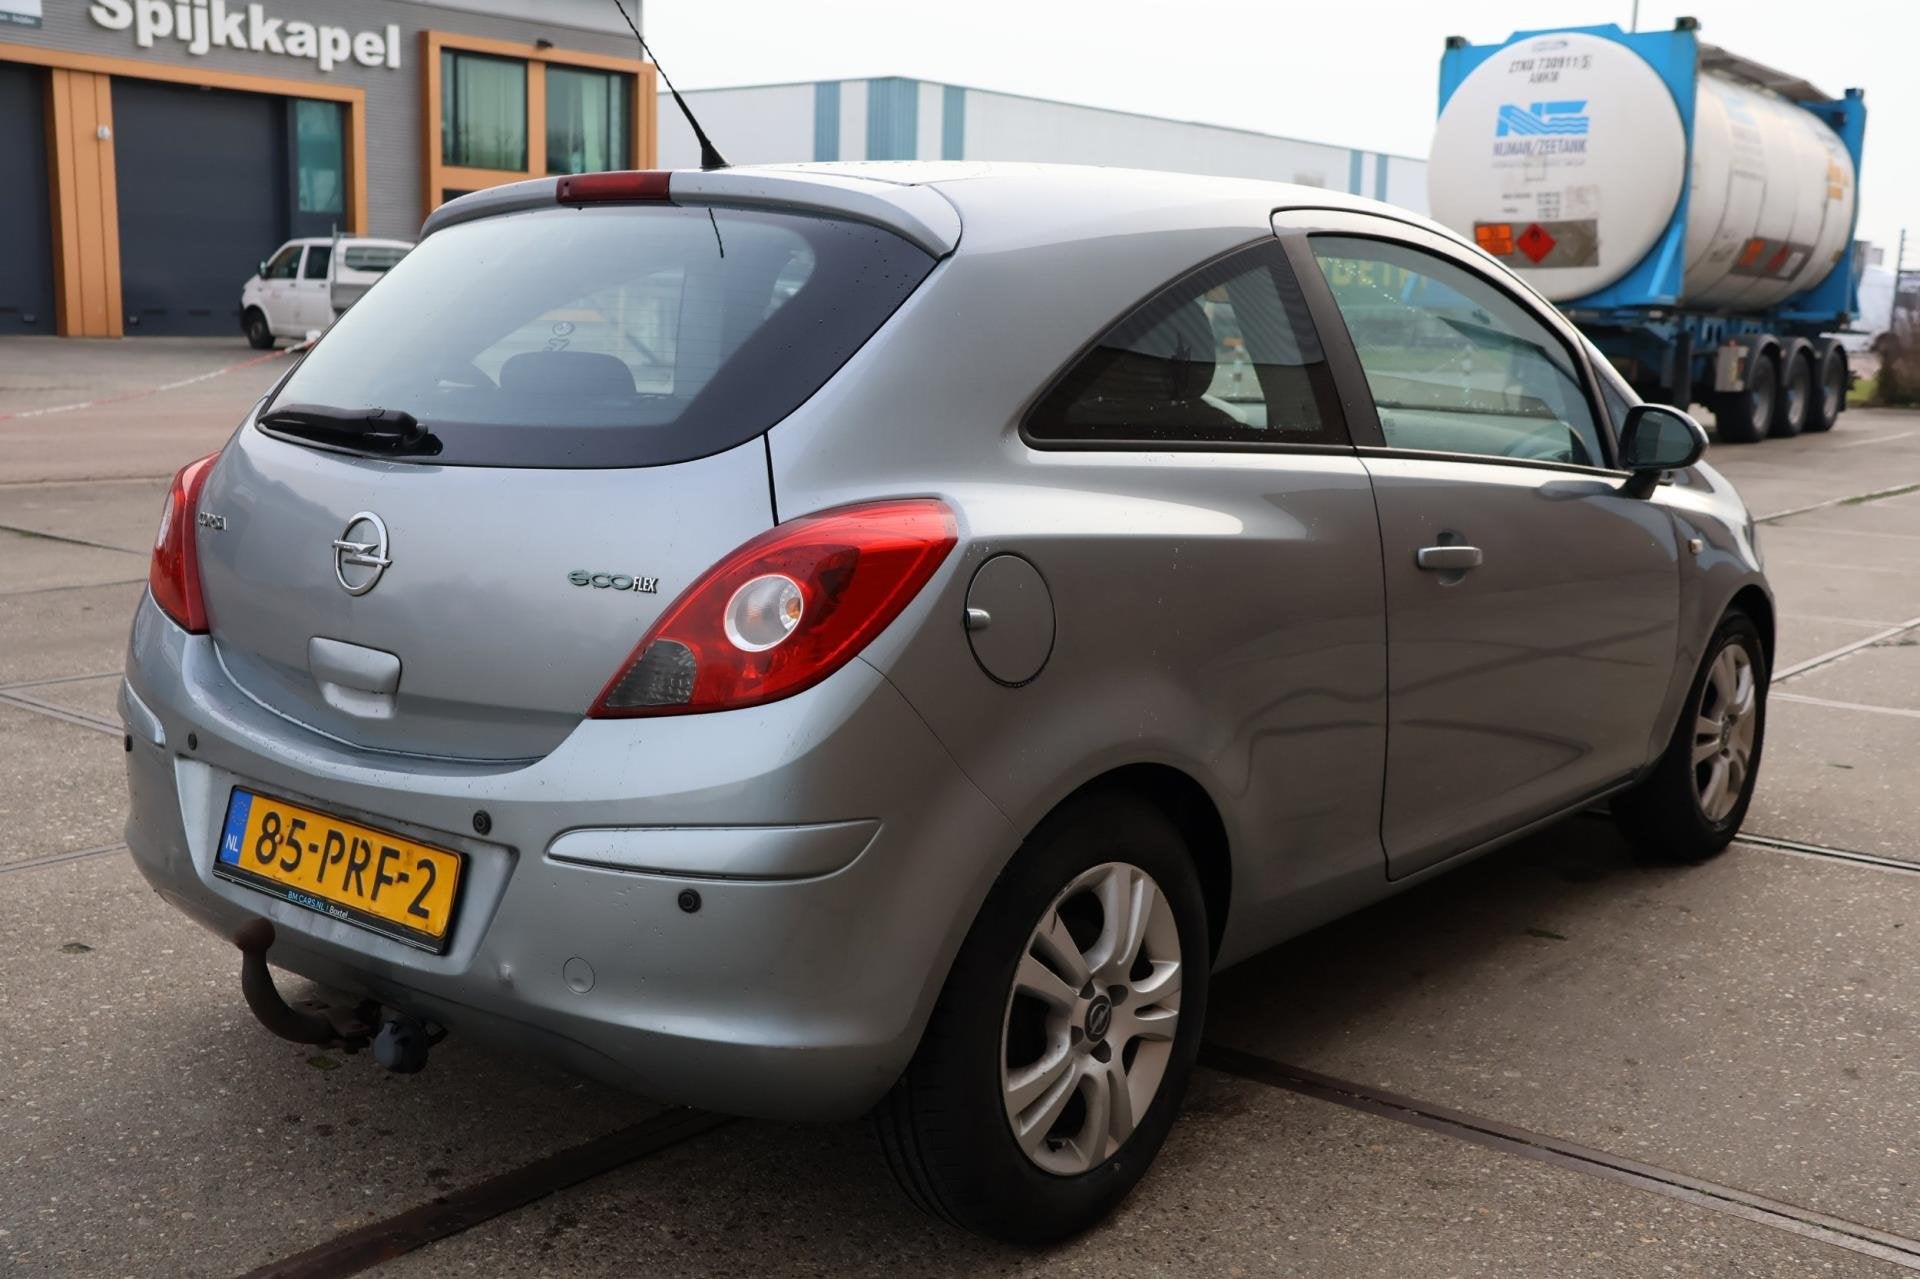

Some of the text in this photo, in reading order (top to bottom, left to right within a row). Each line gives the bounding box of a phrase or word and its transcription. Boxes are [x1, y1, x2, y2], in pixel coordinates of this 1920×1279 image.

[90, 0, 400, 71] Spijkkapel
[225, 833, 238, 852] NL
[255, 811, 437, 919] 85-PRF-2
[329, 905, 349, 919] Boxtel
